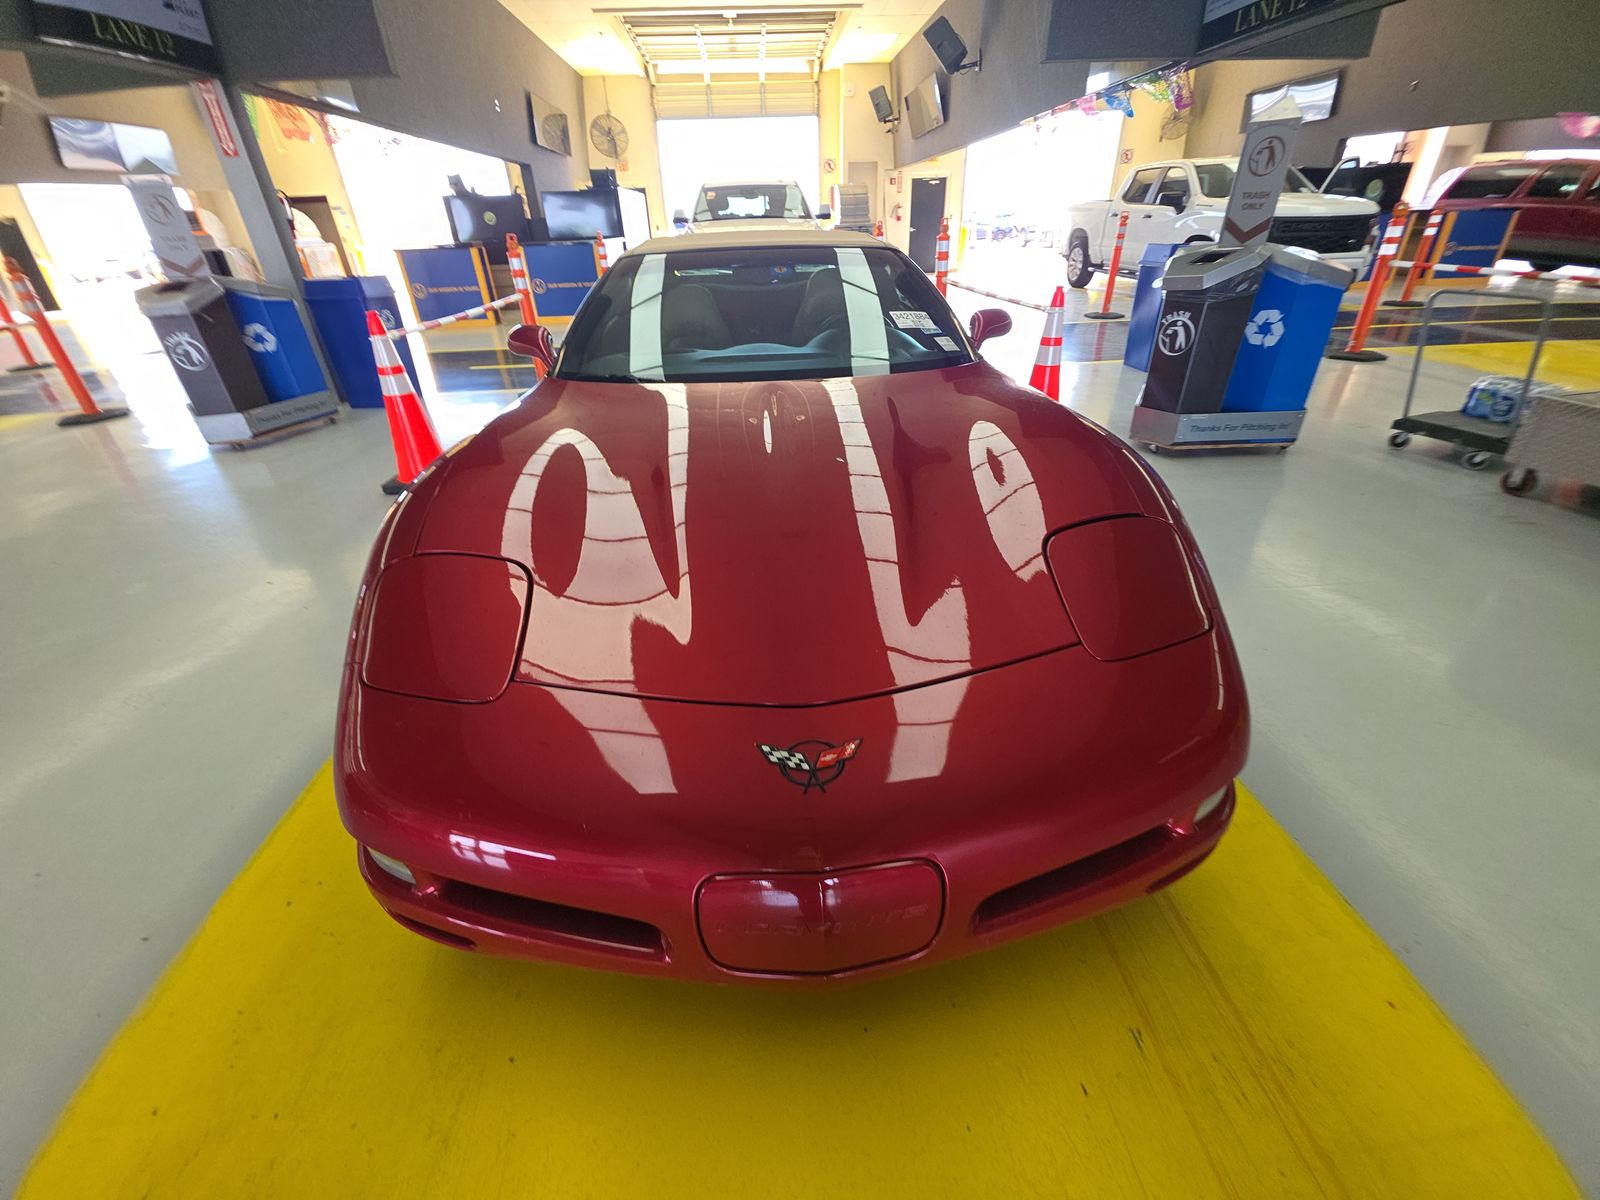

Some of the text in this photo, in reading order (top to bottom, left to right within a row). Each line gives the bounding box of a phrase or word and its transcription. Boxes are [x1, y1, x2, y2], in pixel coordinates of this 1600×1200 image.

[1234, 0, 1283, 32] LANE
[90, 11, 154, 51] LANE
[1242, 191, 1272, 200] TRASH
[1161, 310, 1191, 325] TRASH
